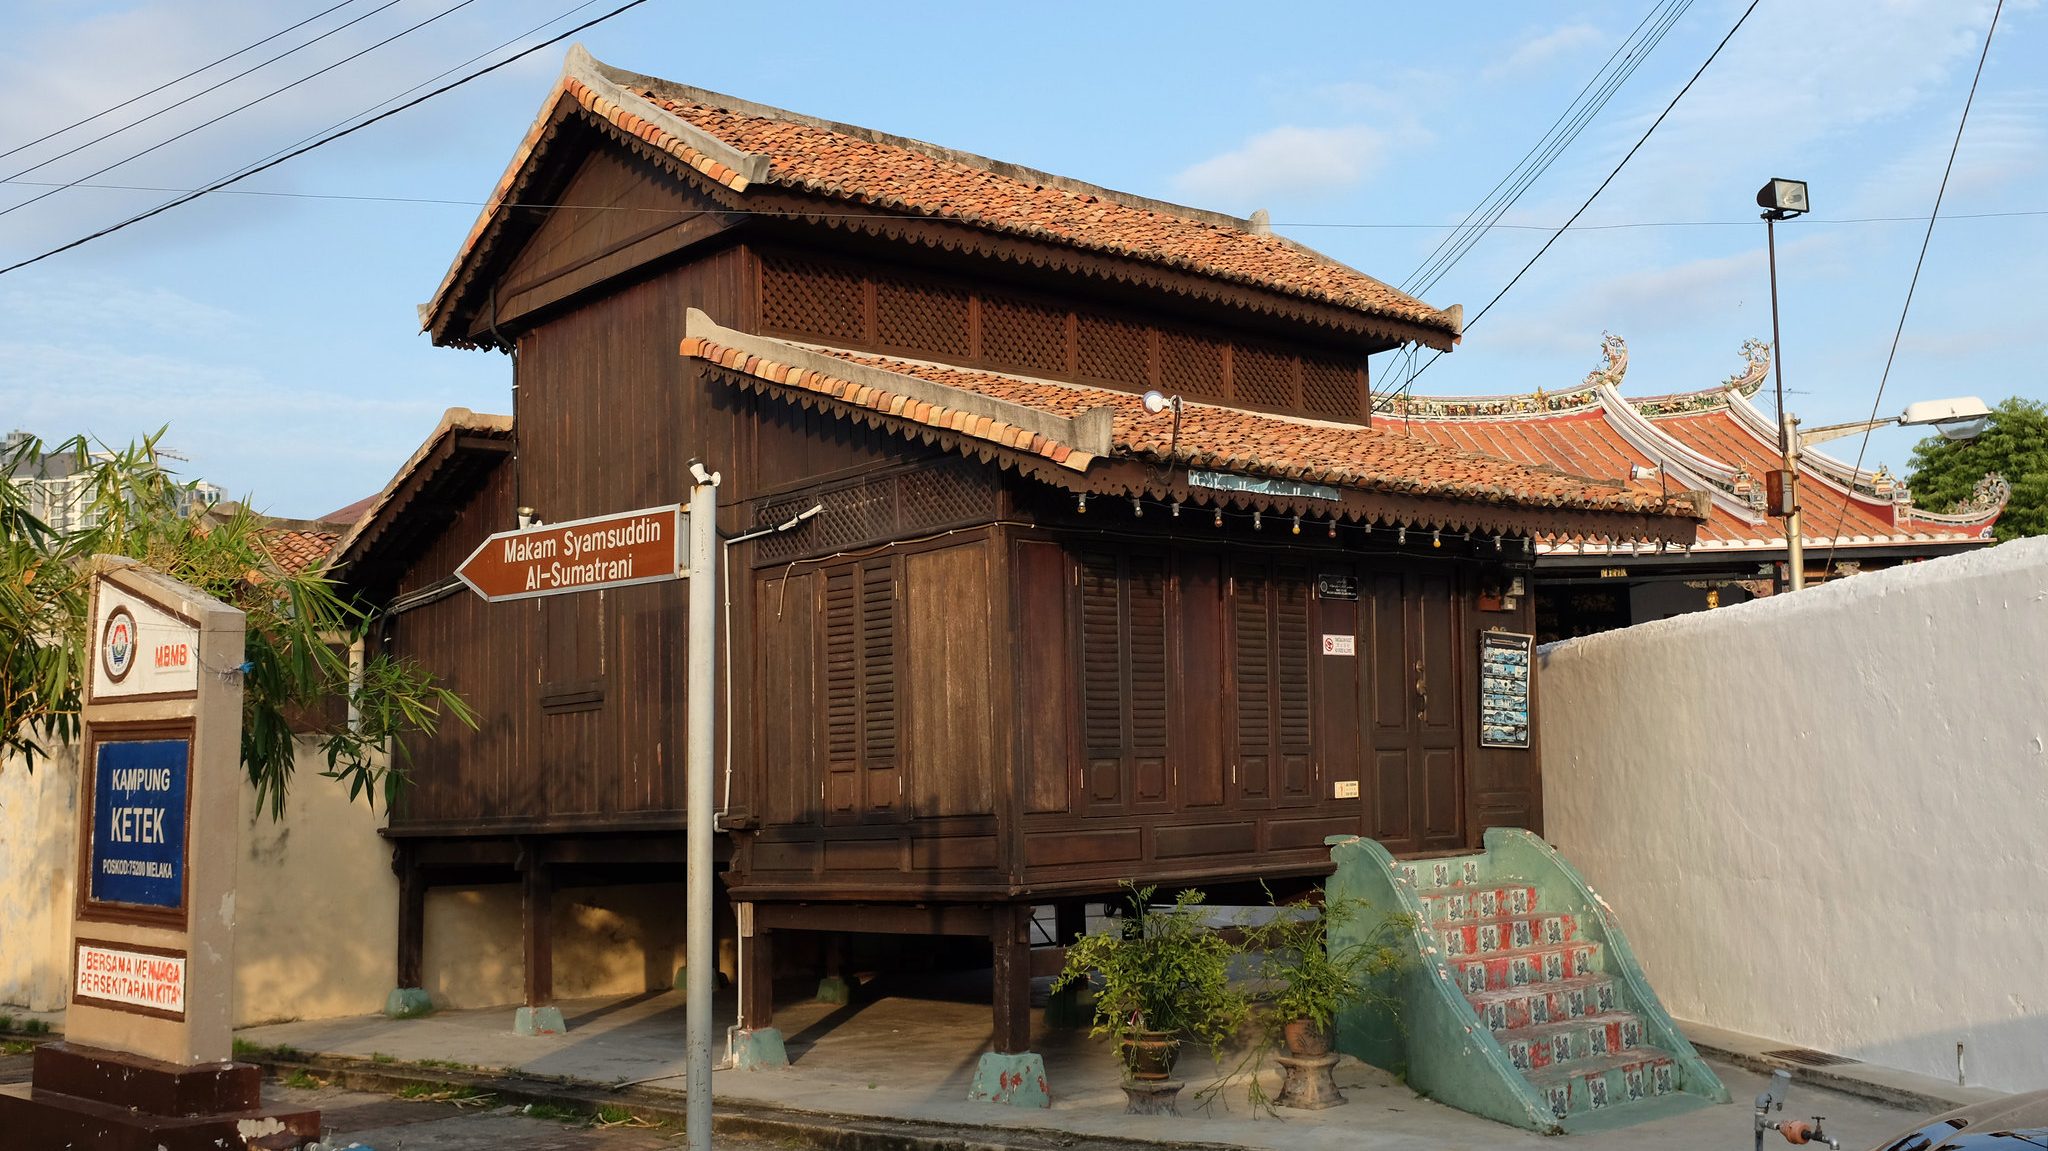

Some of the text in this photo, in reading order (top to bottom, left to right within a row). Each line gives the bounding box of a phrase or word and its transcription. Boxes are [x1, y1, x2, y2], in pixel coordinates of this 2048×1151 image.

[504, 519, 660, 563] Makam Syamsuddin
[526, 554, 632, 590] Al-Sumatrani
[155, 644, 187, 667] MBMB
[112, 769, 170, 791] KAMPUNG
[111, 807, 165, 843] KETEK
[146, 861, 172, 879] MELAKA
[135, 958, 180, 983] MENJAGA
[81, 972, 154, 1000] PERSEKITARAN
